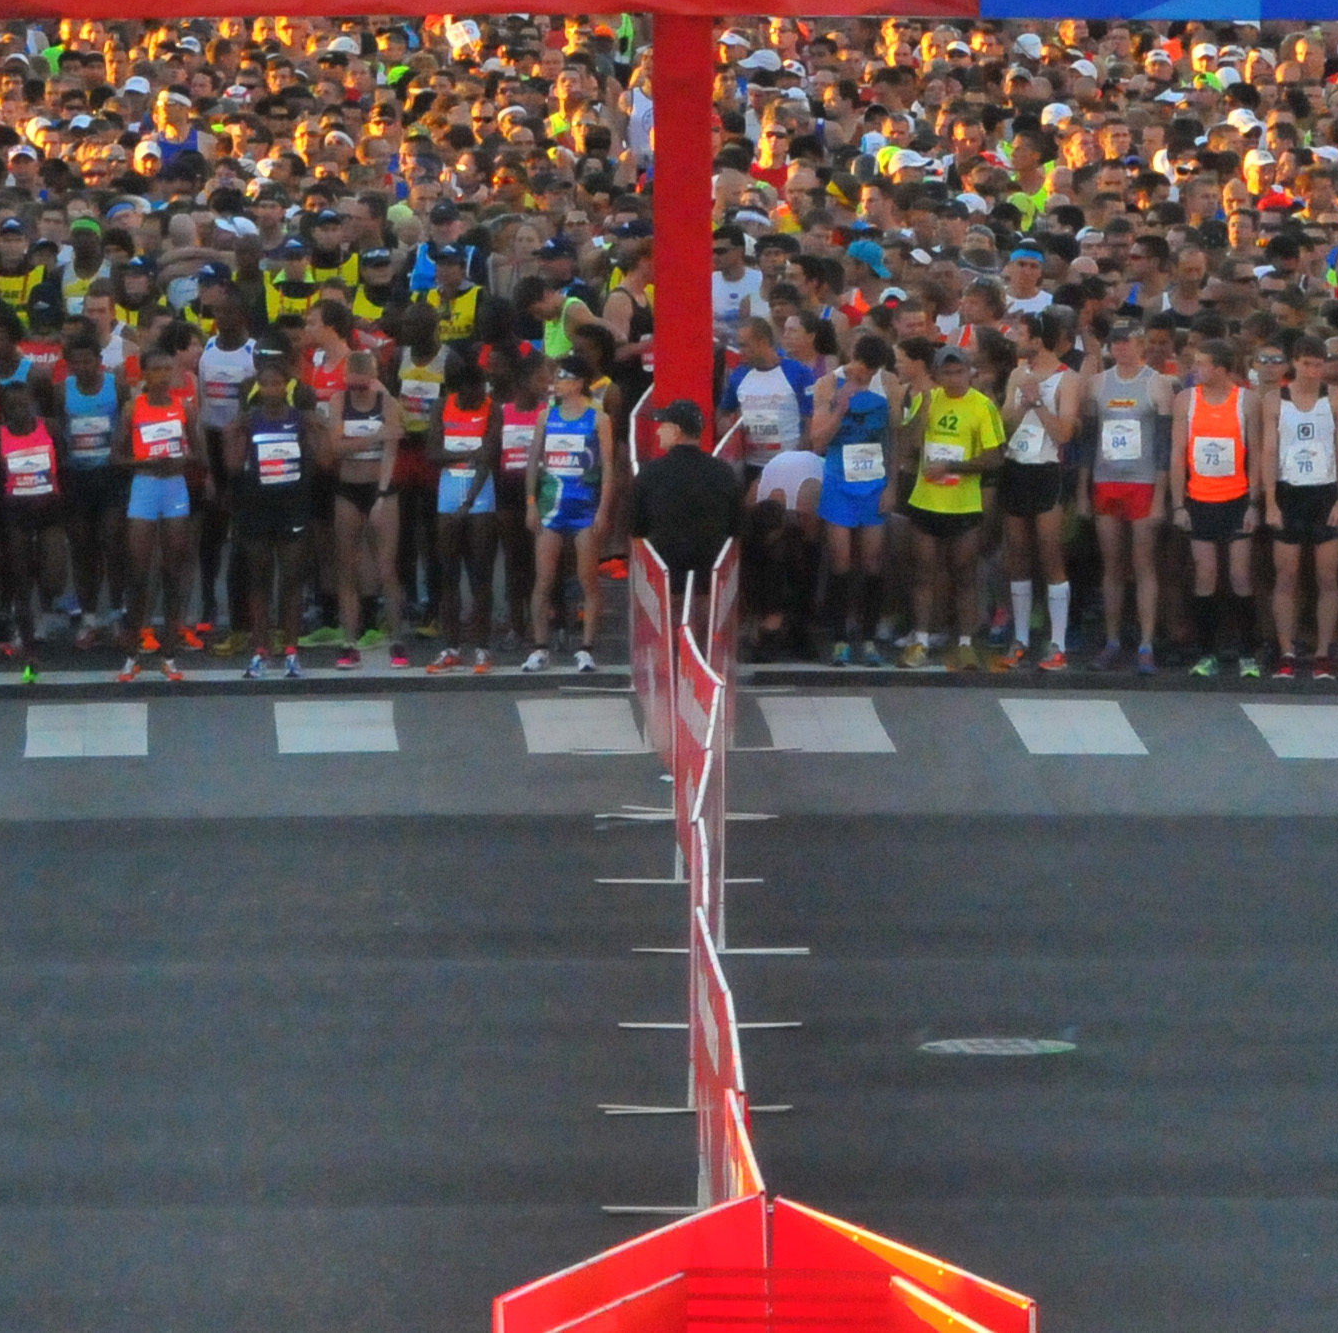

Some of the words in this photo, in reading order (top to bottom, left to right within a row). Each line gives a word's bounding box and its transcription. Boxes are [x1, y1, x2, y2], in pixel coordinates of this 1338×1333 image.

[937, 415, 959, 432] 42
[1111, 436, 1128, 449] 84
[547, 455, 580, 468] AKABA
[852, 459, 874, 472] 337
[1204, 453, 1221, 466] 73
